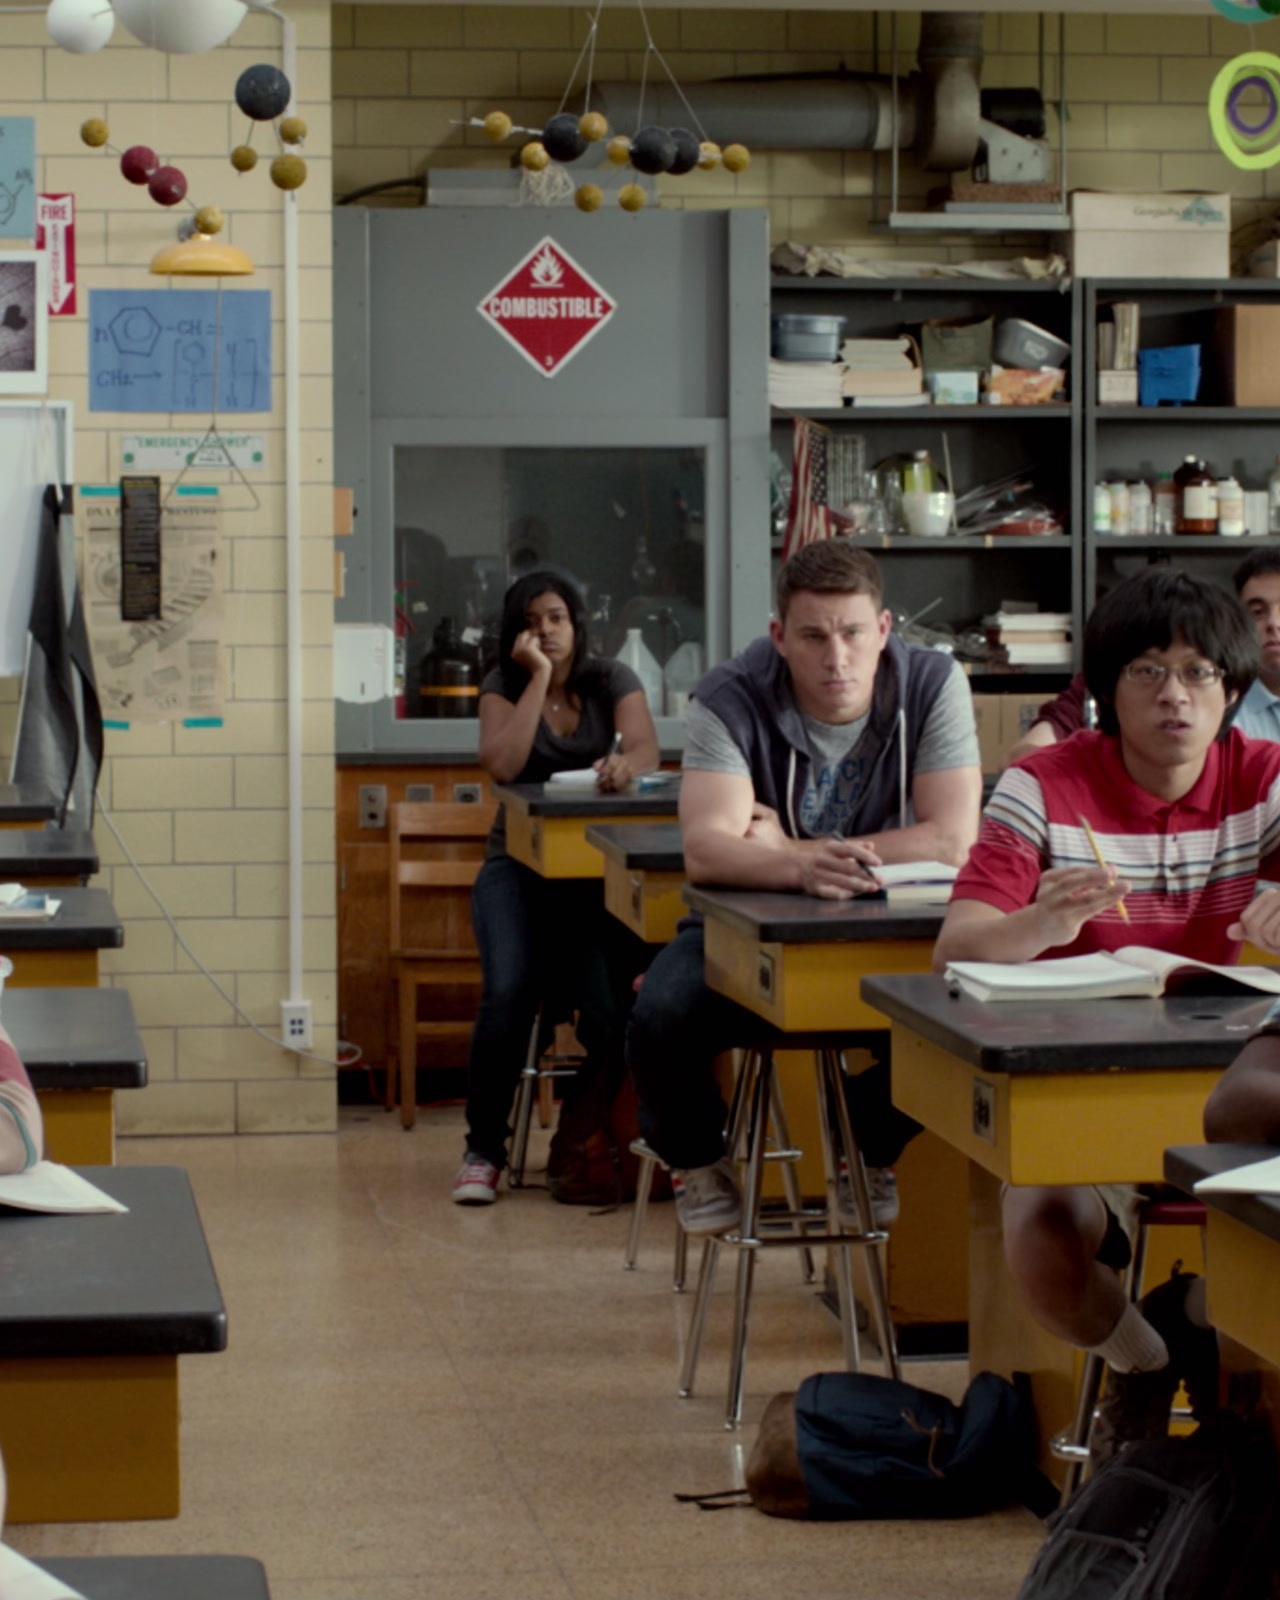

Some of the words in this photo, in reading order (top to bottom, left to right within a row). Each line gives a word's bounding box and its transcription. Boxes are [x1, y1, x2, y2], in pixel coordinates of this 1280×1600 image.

[41, 204, 67, 219] FIRE
[490, 297, 603, 318] COMBUSTIBLE
[545, 355, 553, 366] 3
[138, 436, 199, 448] EMERGENCY
[86, 506, 112, 517] DNA
